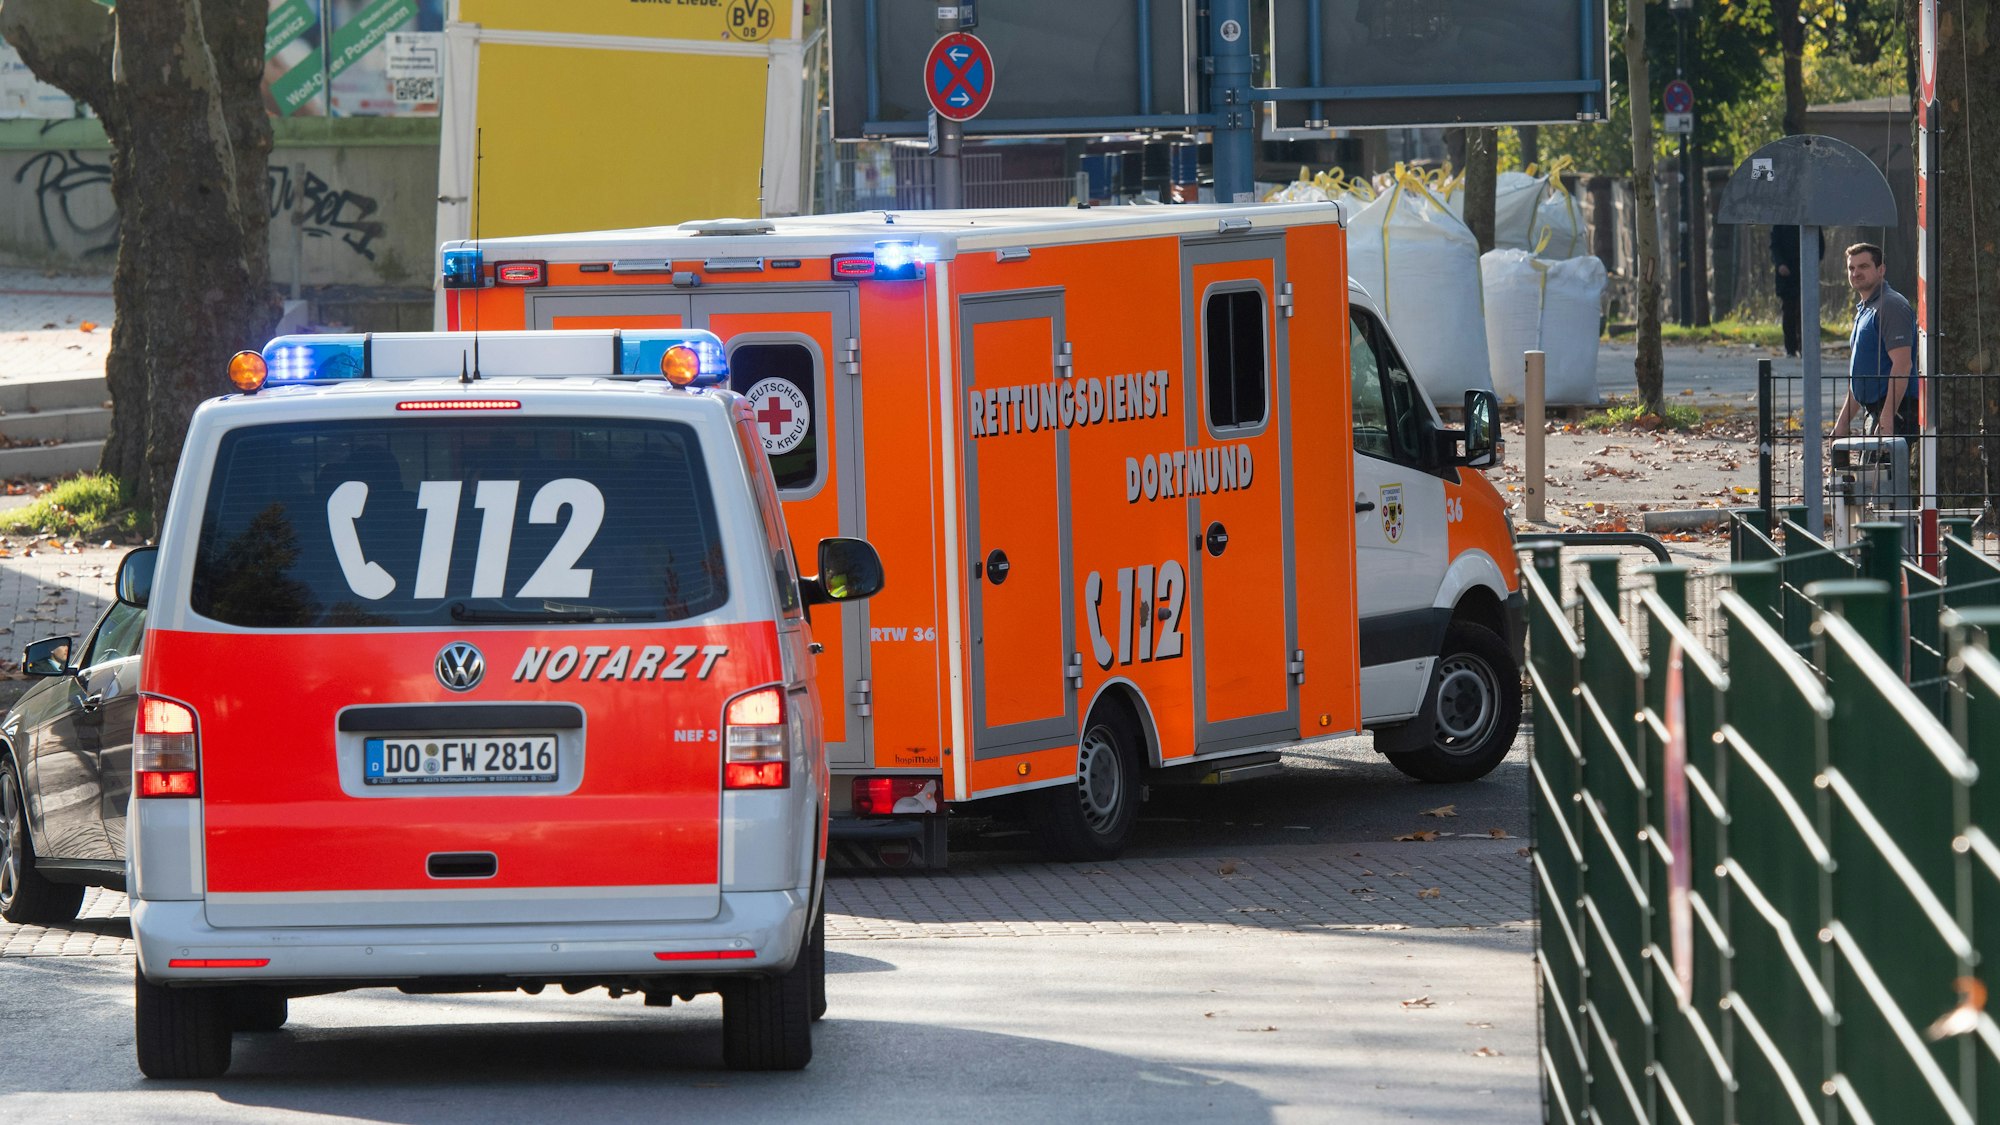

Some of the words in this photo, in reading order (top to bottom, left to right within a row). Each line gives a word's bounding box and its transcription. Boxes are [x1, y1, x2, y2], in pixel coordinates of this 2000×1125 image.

[733, 0, 769, 28] BVB
[344, 6, 410, 59] Poschmann
[743, 27, 756, 37] 09
[750, 382, 803, 408] DEUTSCHES
[970, 370, 1169, 438] RETTUNGSDIENST
[777, 417, 805, 450] KREUZ
[1126, 444, 1253, 504] DORTMUND
[1446, 497, 1463, 523] 36
[414, 478, 605, 599] 112
[1117, 559, 1186, 666] 112
[870, 627, 908, 641] RTW
[913, 627, 936, 641] 36
[511, 645, 728, 682] NOTARZT
[674, 729, 704, 742] NEF
[707, 729, 718, 742] 3
[371, 762, 380, 772] D
[386, 744, 420, 773] DO
[442, 742, 476, 772] FW
[484, 742, 552, 771] 2816
